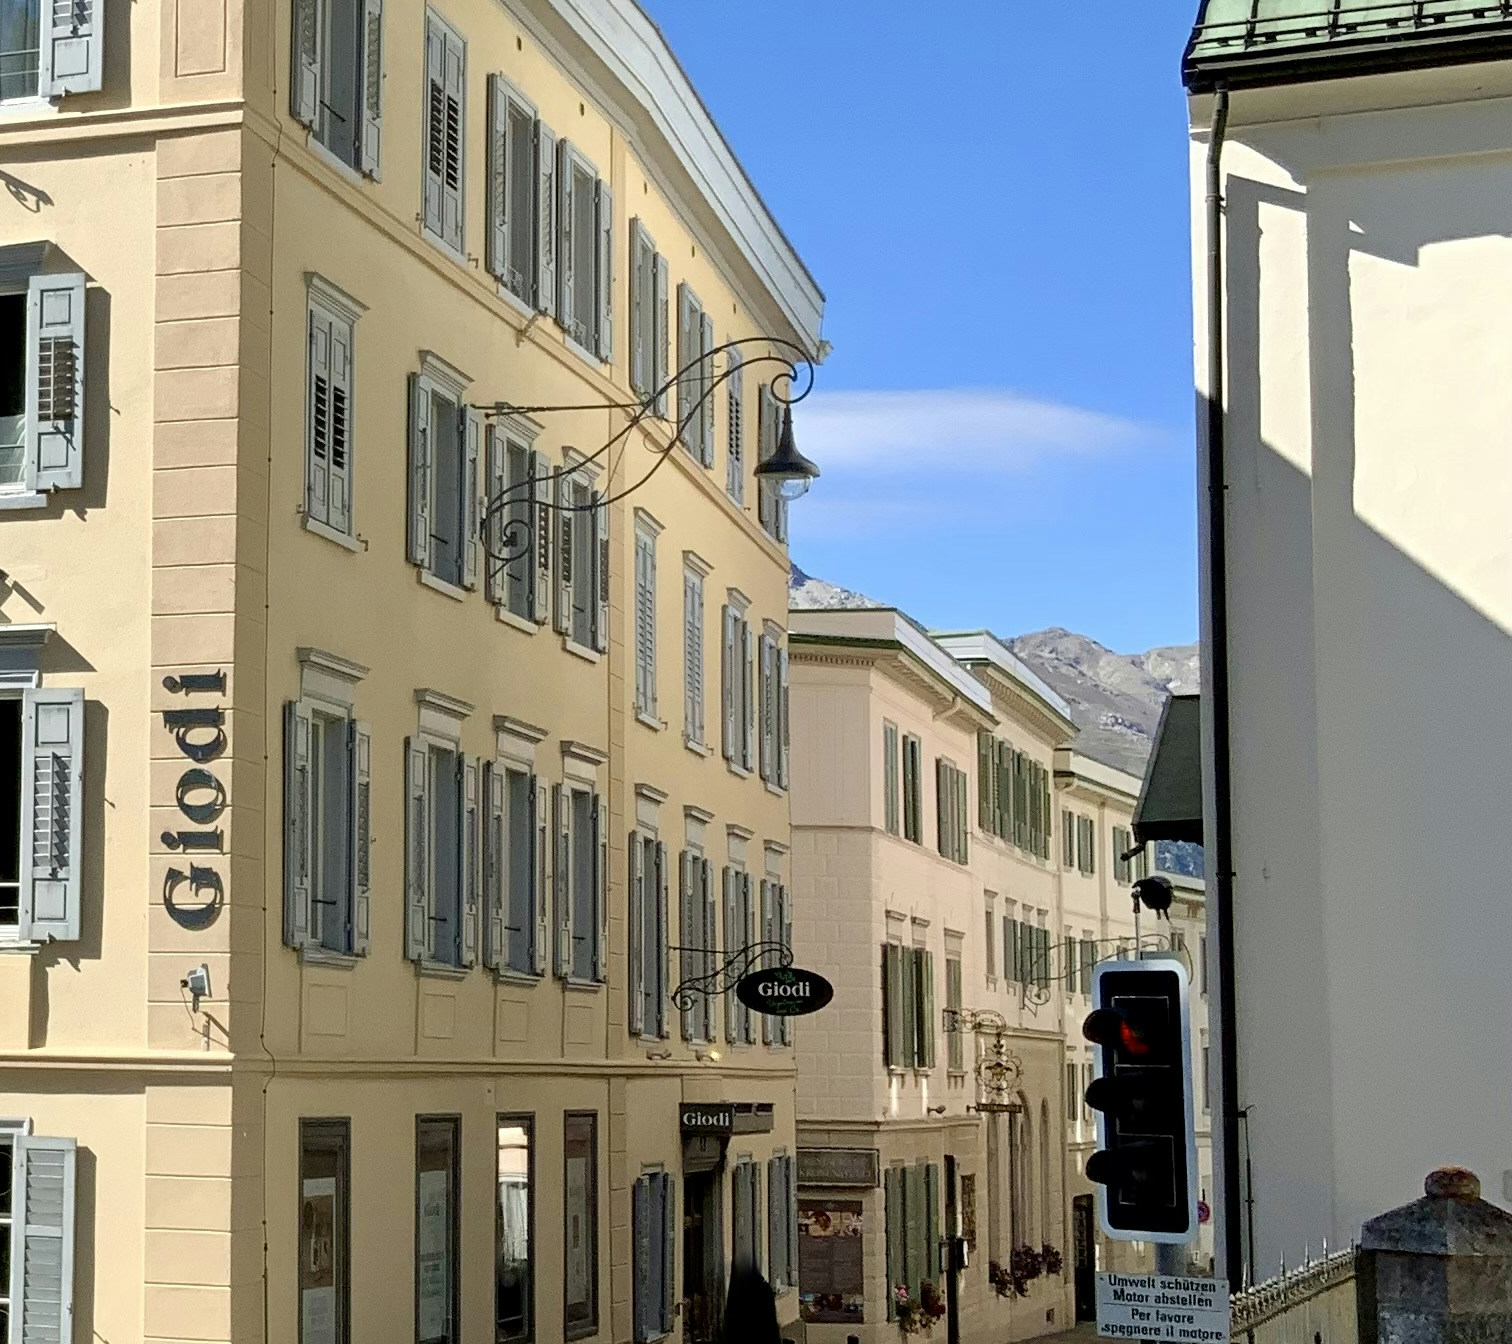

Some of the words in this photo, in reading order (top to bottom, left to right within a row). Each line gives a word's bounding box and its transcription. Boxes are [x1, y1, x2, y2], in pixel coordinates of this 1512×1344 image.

[161, 667, 227, 931] Giodi
[757, 980, 811, 997] Giodi
[682, 1111, 730, 1127] Giodi
[1107, 1273, 1156, 1289] Umwelt
[1159, 1277, 1216, 1293] schützen
[1112, 1287, 1150, 1304] Motor
[1154, 1291, 1213, 1308] abstellen
[1131, 1308, 1151, 1322] Per
[1155, 1310, 1195, 1324] favore
[1103, 1321, 1161, 1336] spegnere
[1165, 1325, 1174, 1335] il
[1178, 1327, 1223, 1341] motore
